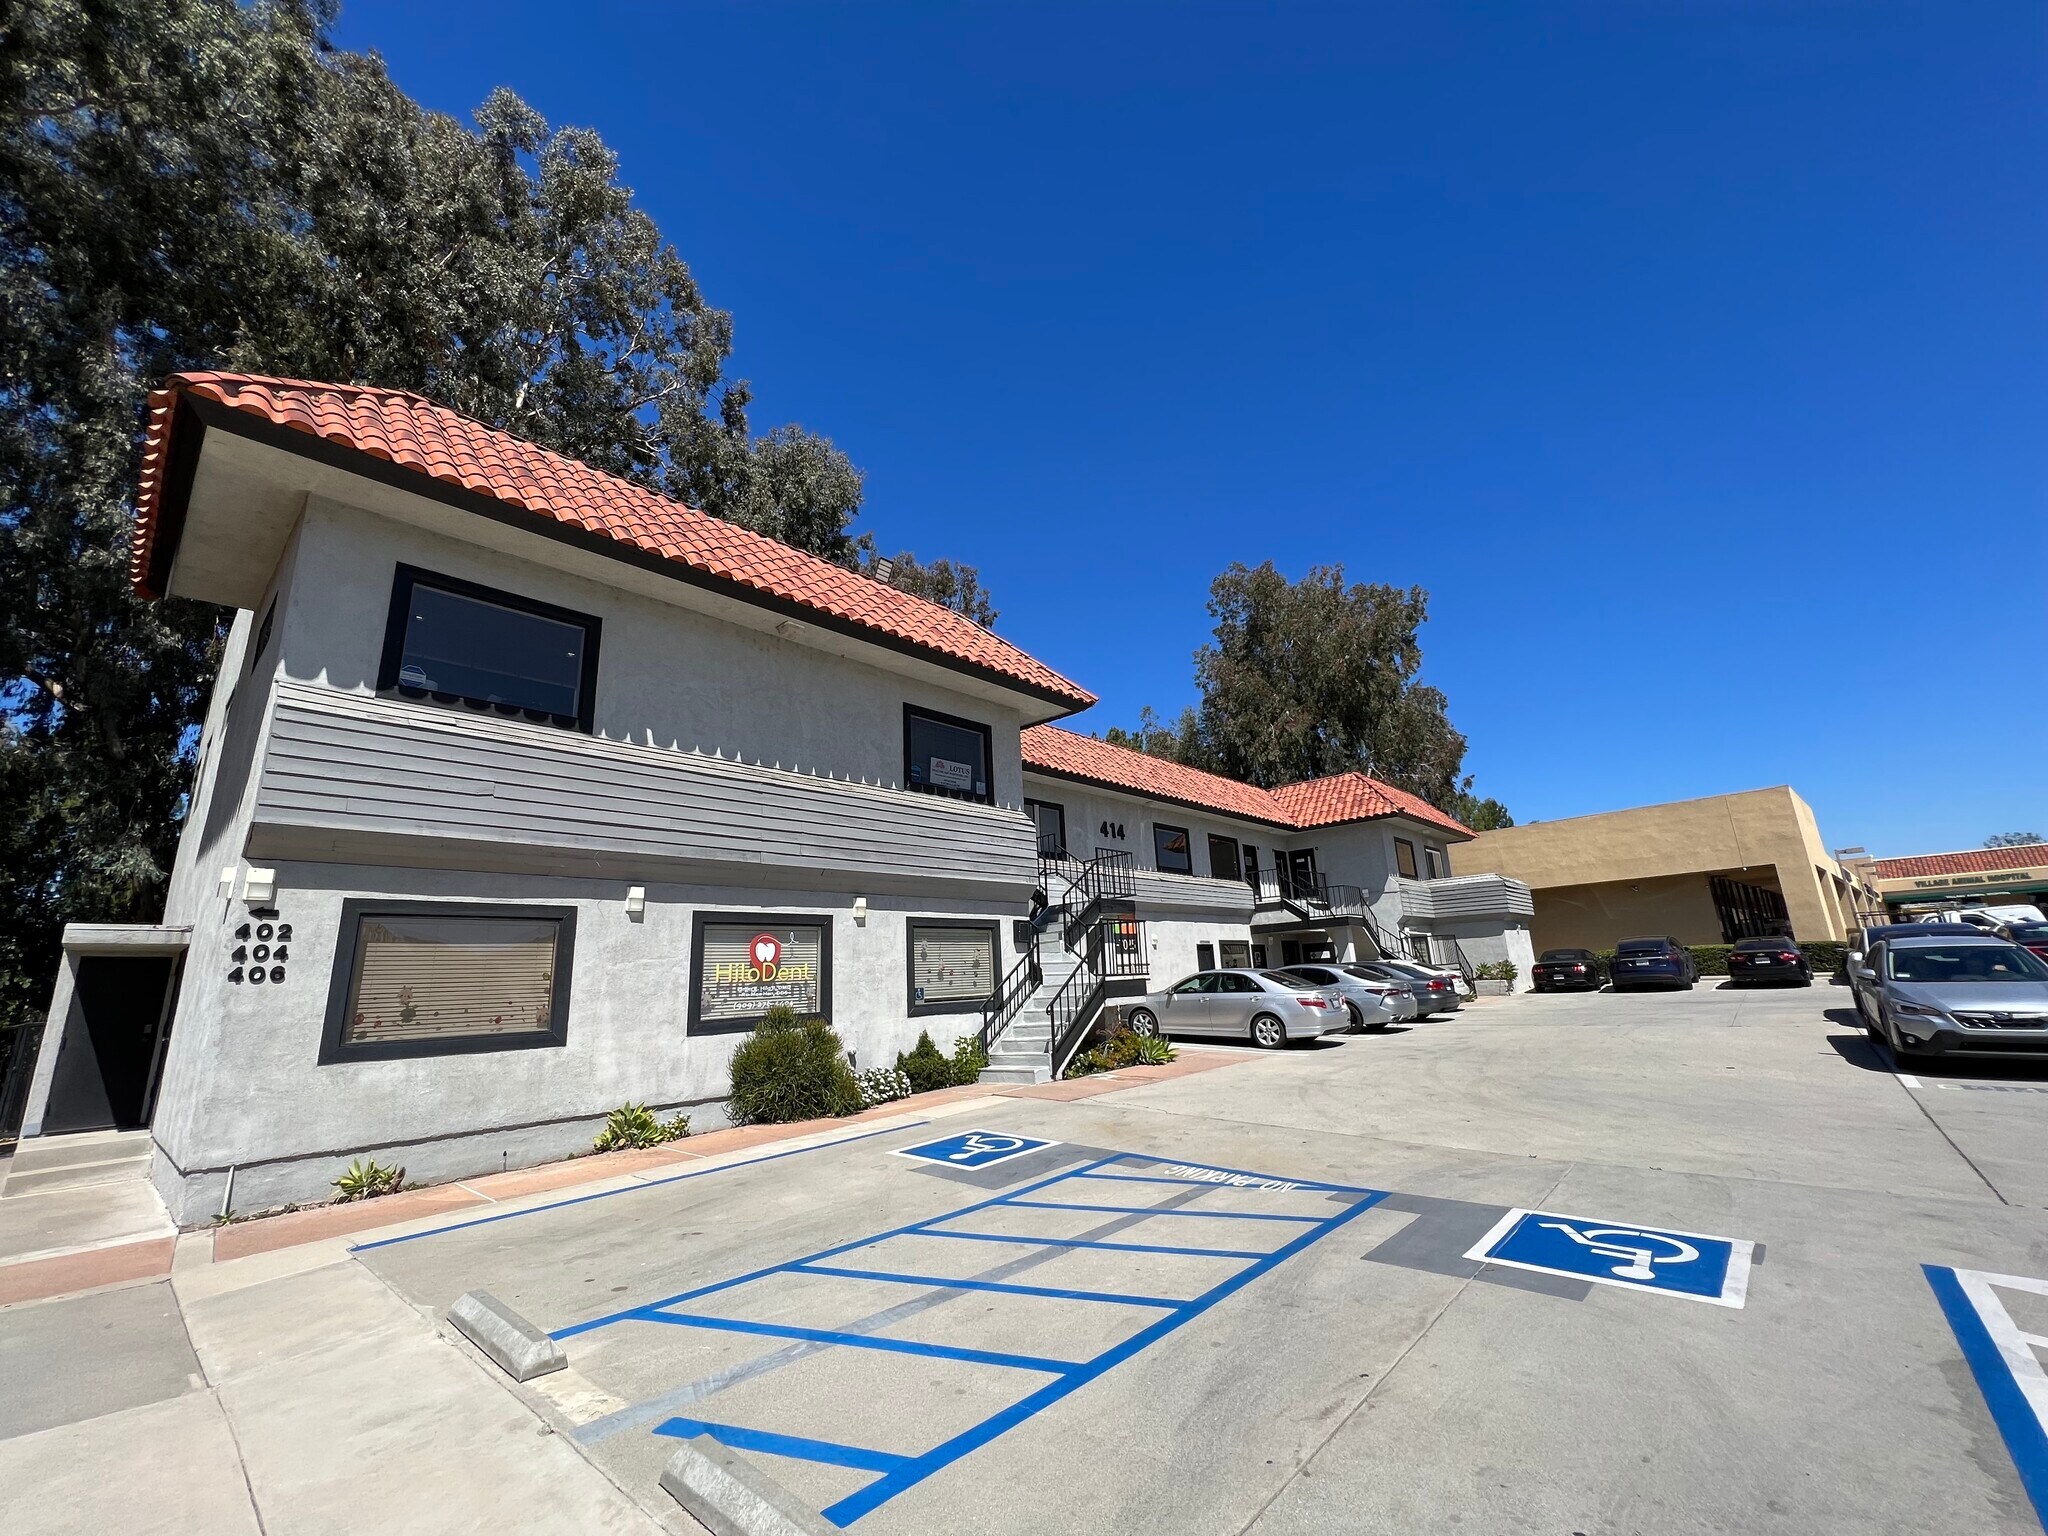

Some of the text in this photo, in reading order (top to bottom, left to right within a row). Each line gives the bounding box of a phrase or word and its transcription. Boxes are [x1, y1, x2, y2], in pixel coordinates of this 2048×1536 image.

[949, 765, 971, 775] LOTUS
[1100, 820, 1126, 840] 414
[1915, 872, 2032, 888] VILLAGE ANIMAL HOSPITAL
[235, 923, 293, 942] 402
[231, 944, 289, 965] 404
[227, 966, 286, 985] 406
[1164, 1165, 1301, 1193] NO PARKING
